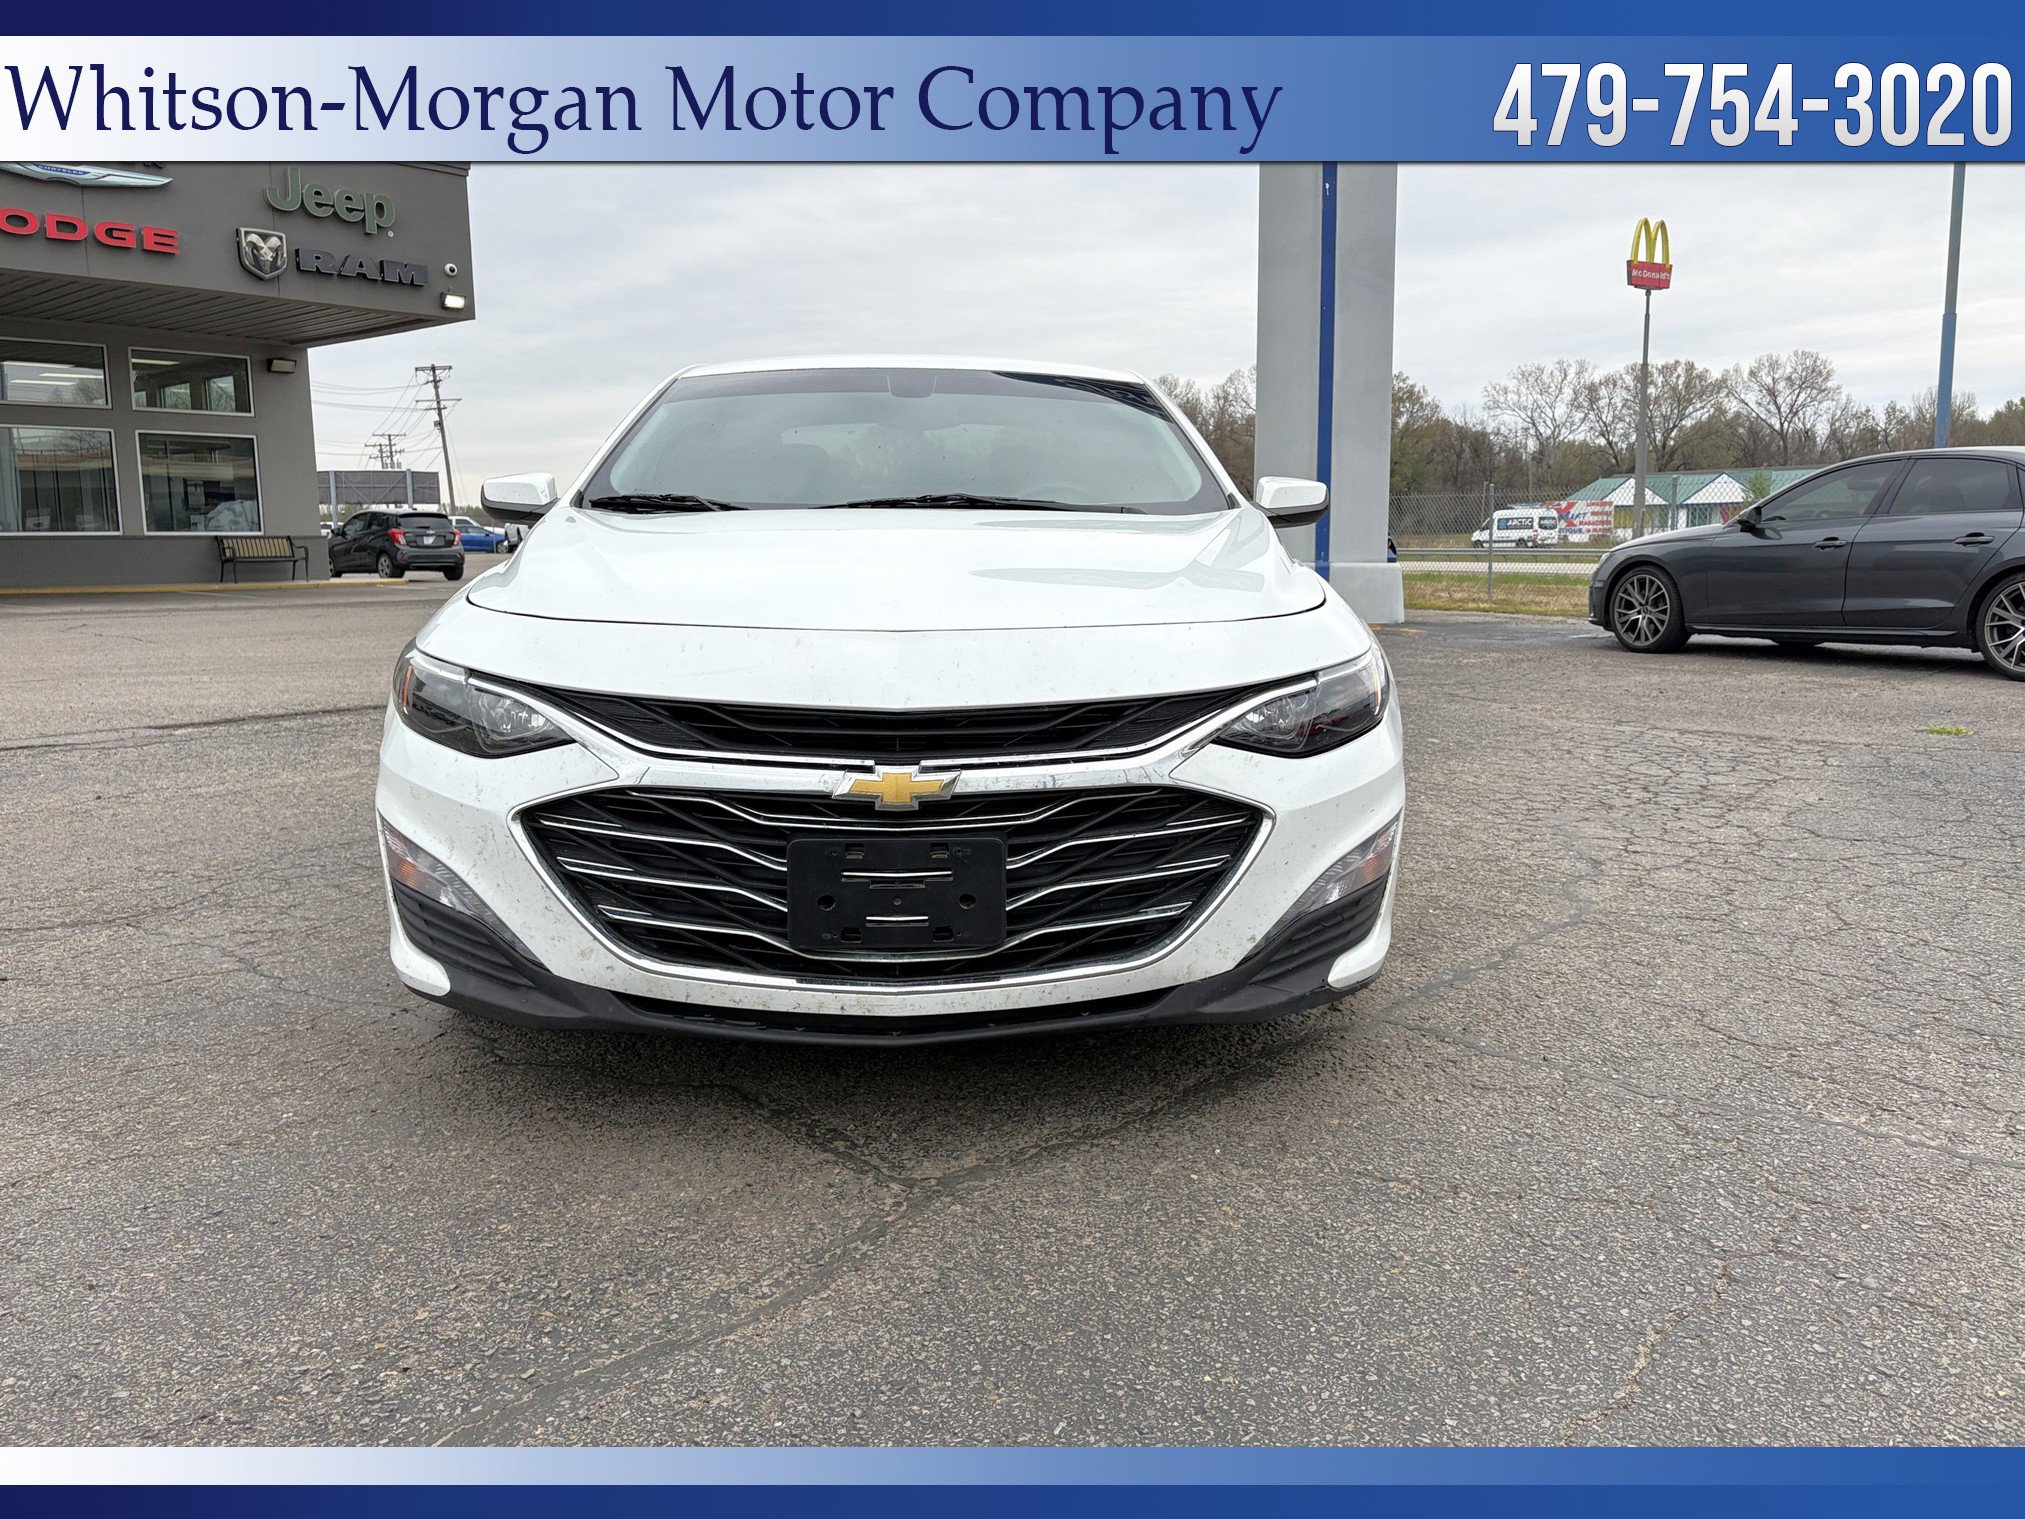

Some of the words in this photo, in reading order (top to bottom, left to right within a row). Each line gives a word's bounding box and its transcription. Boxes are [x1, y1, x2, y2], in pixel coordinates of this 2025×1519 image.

[37, 164, 84, 175] CHRYSLER
[266, 167, 396, 234] Jeep
[297, 248, 429, 286] RAM
[1631, 268, 1670, 280] McDonald's
